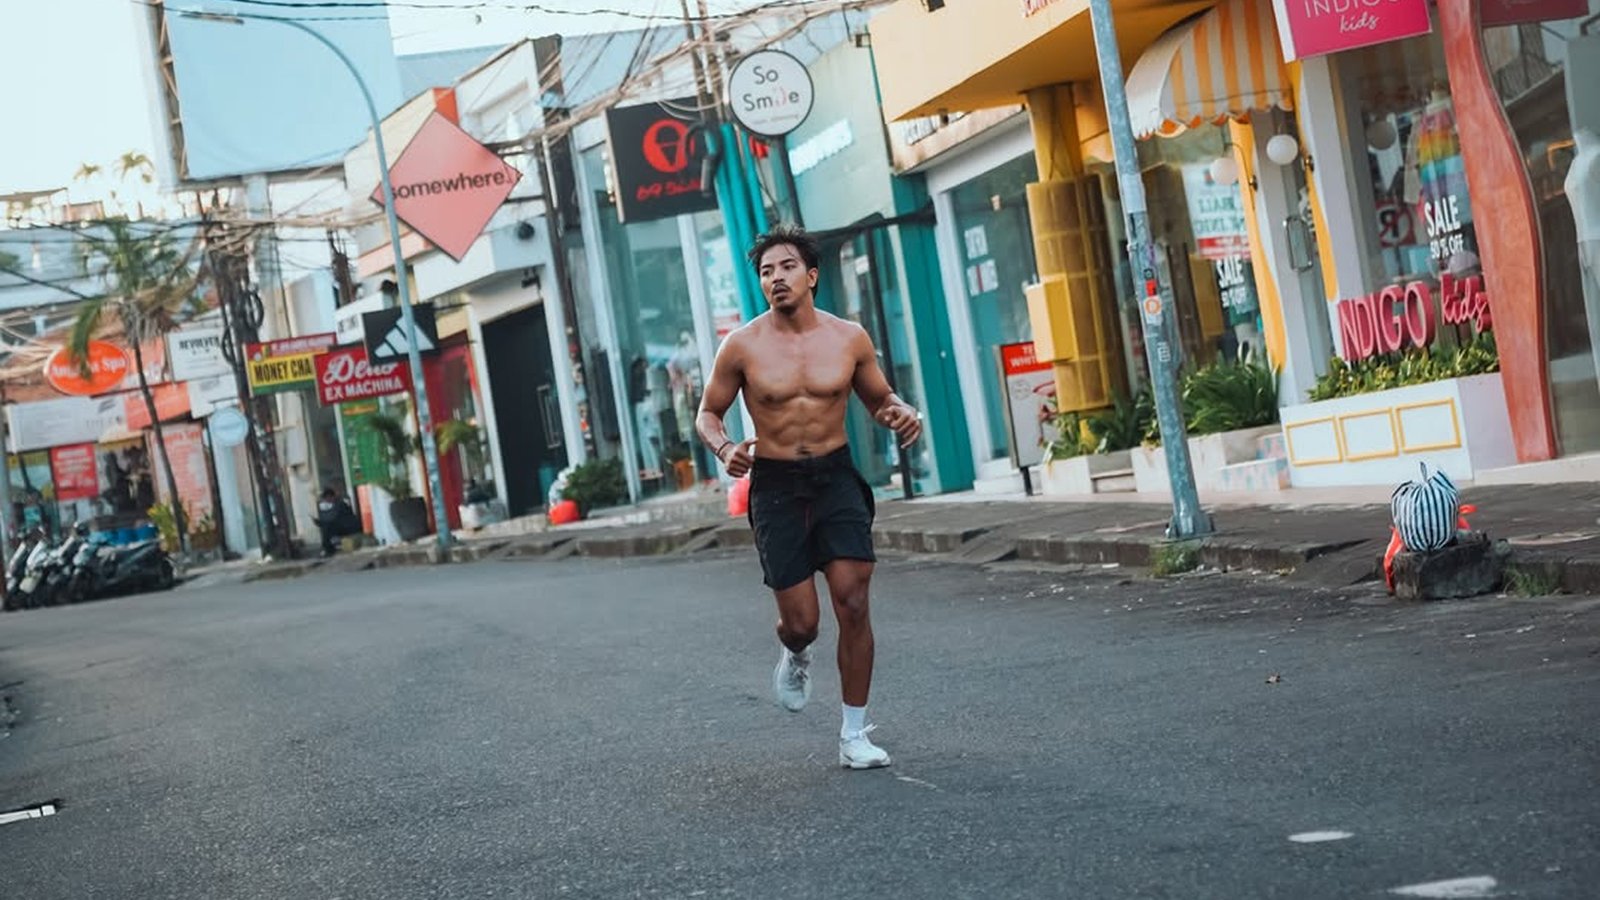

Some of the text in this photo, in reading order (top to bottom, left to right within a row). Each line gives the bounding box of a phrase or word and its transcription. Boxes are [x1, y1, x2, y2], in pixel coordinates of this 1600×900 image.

[1339, 11, 1380, 33] kids
[752, 65, 779, 85] So
[1424, 195, 1461, 238] SALE
[1216, 254, 1244, 290] SALE
[1438, 271, 1489, 334] kids
[253, 360, 289, 383] MONEY
[324, 376, 403, 402] EX MACHINA
